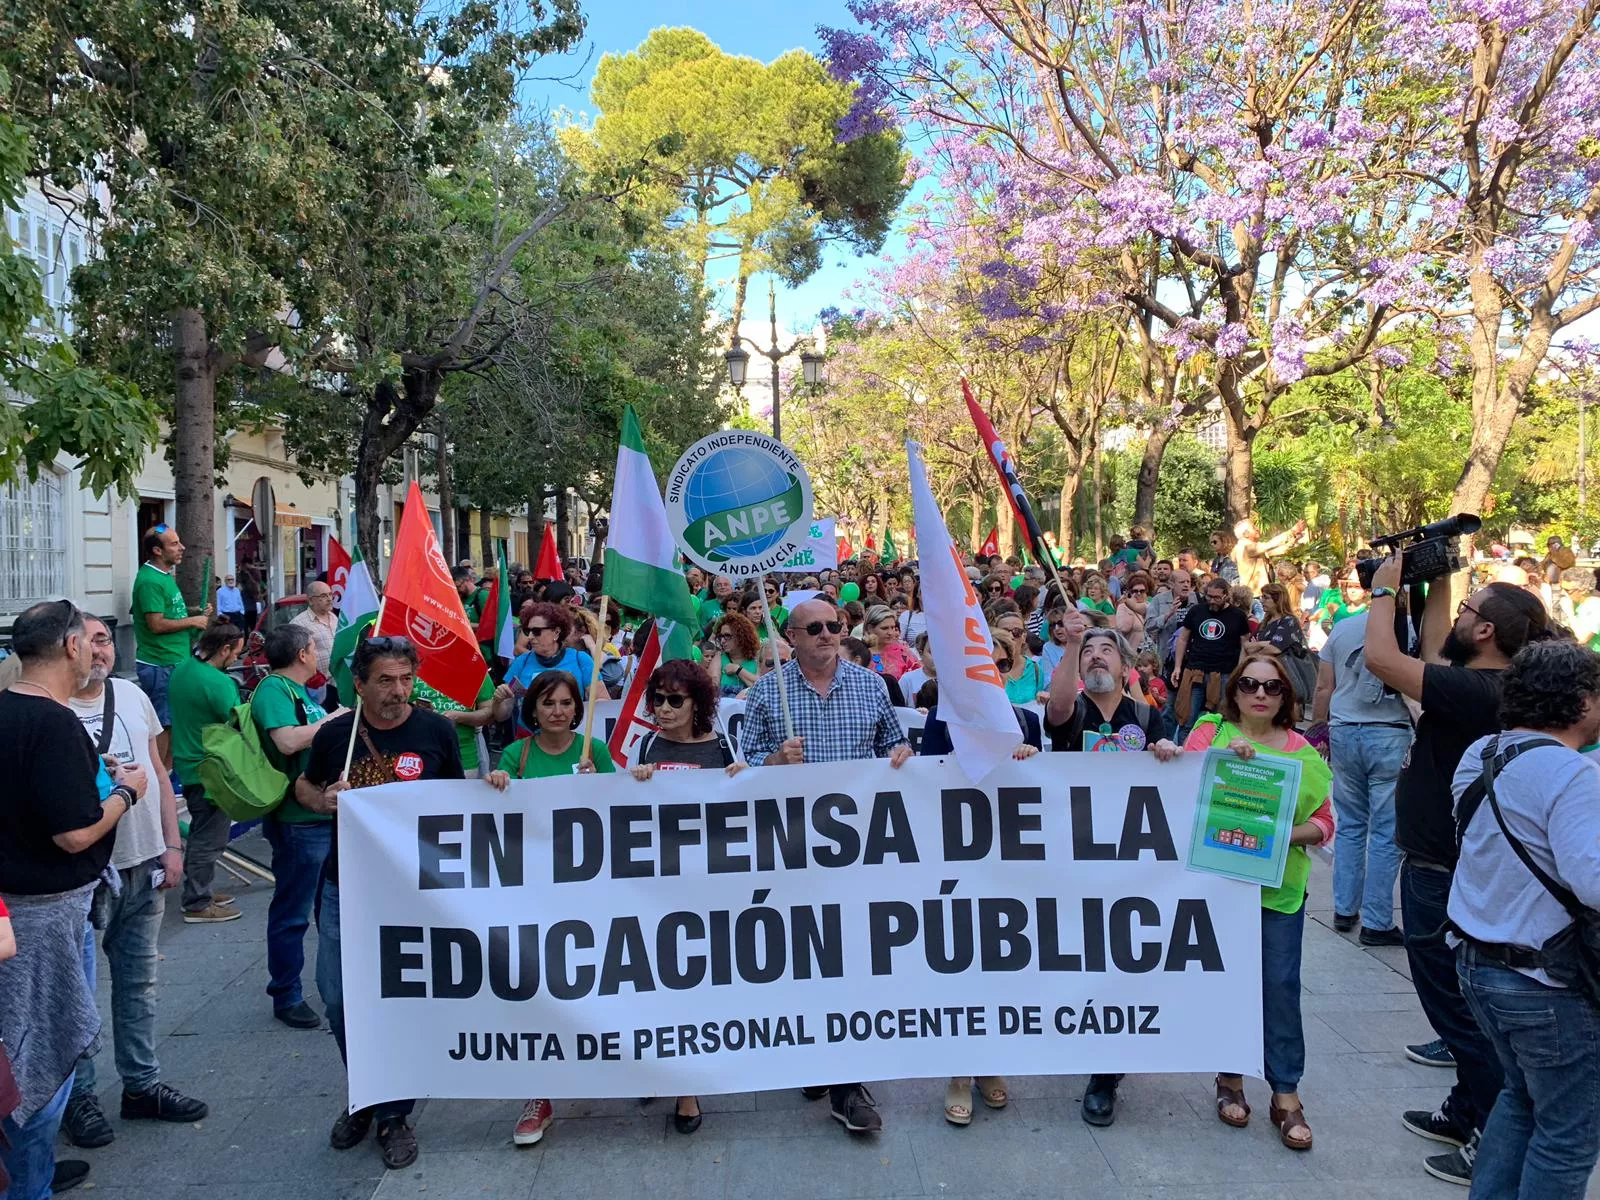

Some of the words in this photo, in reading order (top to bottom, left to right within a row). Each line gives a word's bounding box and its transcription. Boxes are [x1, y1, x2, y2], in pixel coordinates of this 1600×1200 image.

[670, 446, 706, 503] SINDICATO
[707, 434, 799, 473] INDEPENDIENTE
[704, 500, 790, 548] ANPE
[807, 525, 823, 538] E
[719, 542, 797, 575] ANDALUCÍA
[398, 755, 420, 769] UGT
[1226, 761, 1275, 777] MANIFESTACIÓN
[1231, 769, 1268, 781] PROVINCIAL
[418, 813, 523, 890] EN
[553, 788, 920, 883] DEFENSA
[941, 787, 1045, 864] DE
[1070, 786, 1178, 860] LA
[380, 888, 843, 1001] EDUCACIÓN
[869, 879, 1224, 975] PÚBLICA
[449, 1033, 564, 1061] JUNTA
[577, 1032, 620, 1061] DE
[634, 1016, 814, 1060] PERSONAL
[827, 1006, 986, 1043] DOCENTE
[999, 1005, 1042, 1036] DE
[1055, 999, 1161, 1037] CÁDIZ
